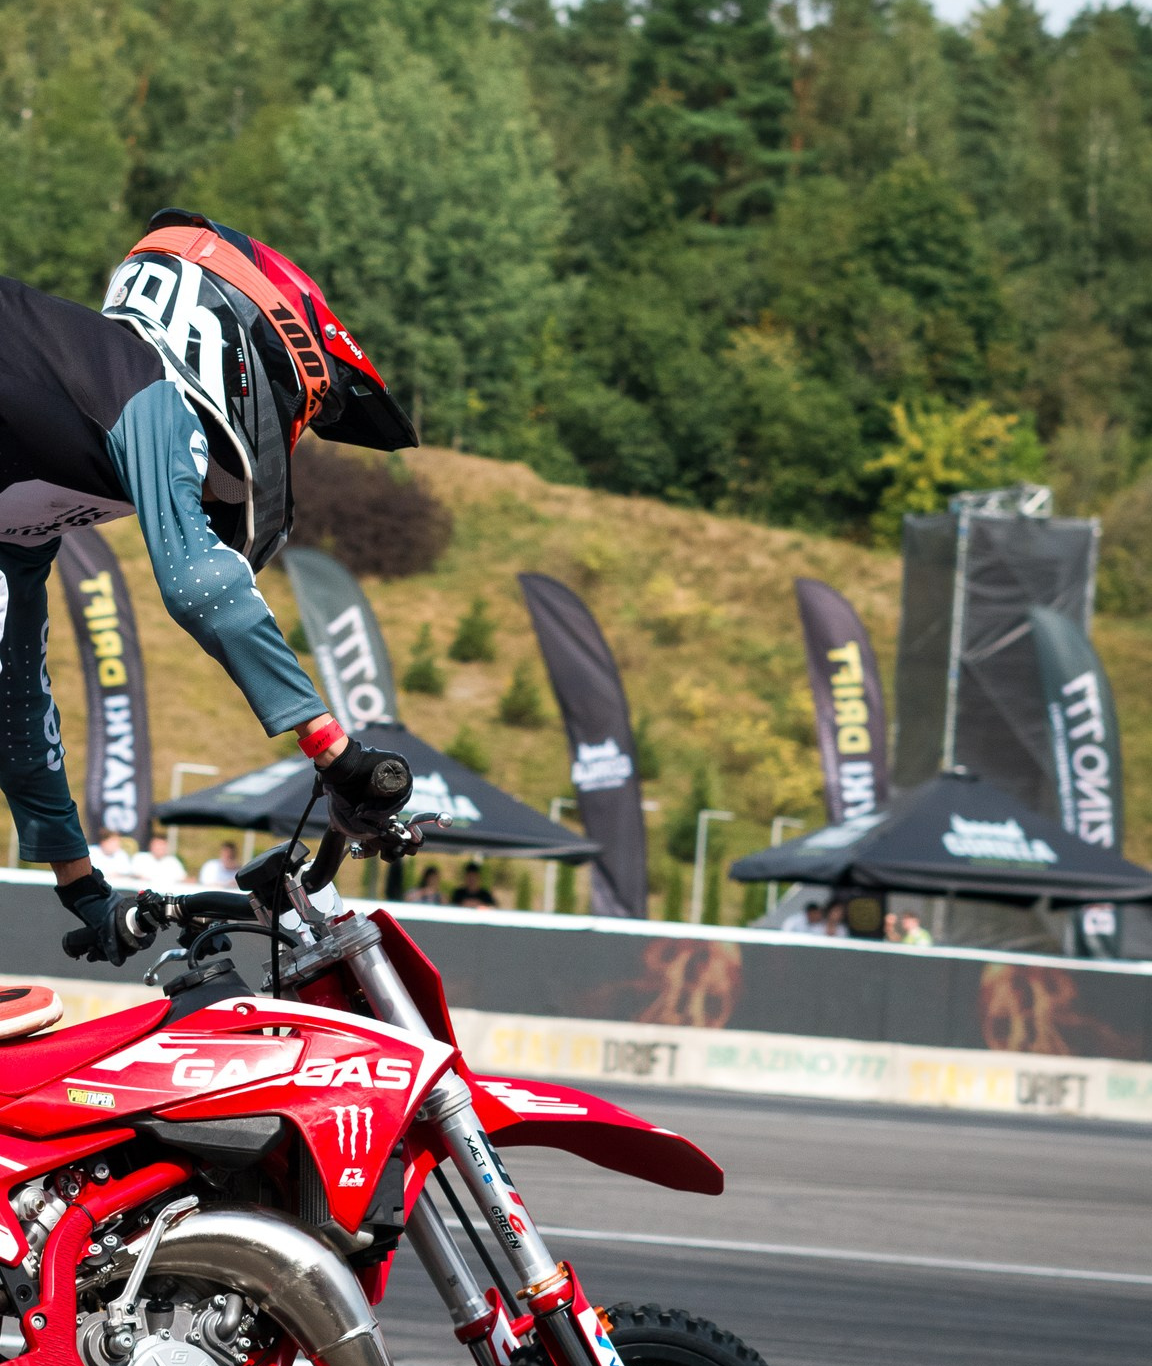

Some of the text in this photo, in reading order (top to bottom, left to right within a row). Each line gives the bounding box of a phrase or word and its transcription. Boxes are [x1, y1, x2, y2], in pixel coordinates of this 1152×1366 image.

[269, 301, 328, 412] 100%
[338, 330, 363, 360] Airoh
[603, 1038, 680, 1077] DRIFT
[1015, 1072, 1089, 1110] DRIFT
[463, 1134, 487, 1168] XACT
[491, 1205, 523, 1250] GREEN
